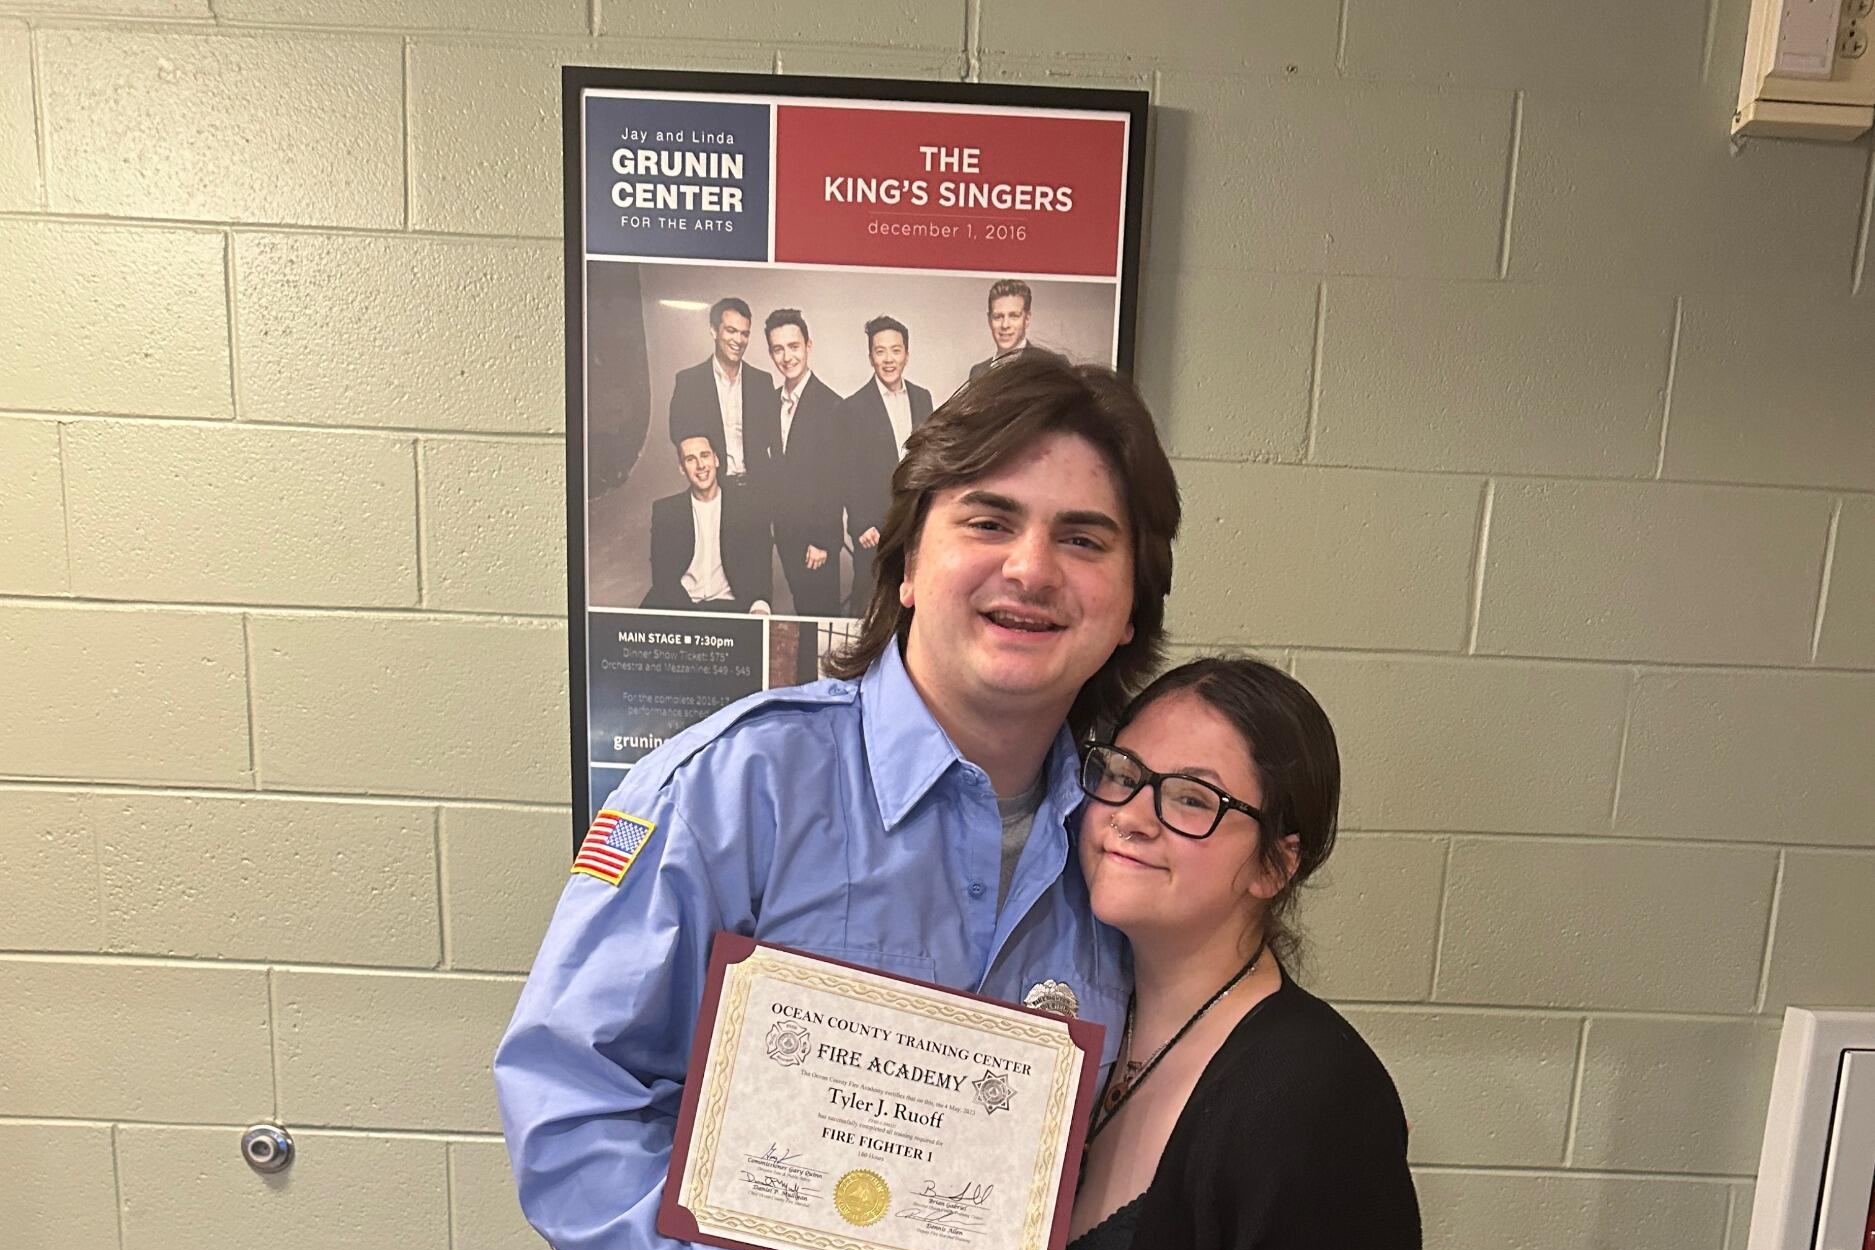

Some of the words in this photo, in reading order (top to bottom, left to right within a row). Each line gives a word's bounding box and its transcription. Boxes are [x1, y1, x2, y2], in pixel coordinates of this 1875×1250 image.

[621, 128, 647, 143] Jay
[656, 130, 684, 142] and
[692, 131, 734, 145] Linda
[612, 148, 744, 179] GRUNIN
[919, 146, 980, 174] THE
[611, 181, 743, 213] CENTER
[825, 176, 929, 206] KING'S
[938, 181, 1073, 212] SINGERS
[621, 216, 651, 228] FOR
[658, 217, 687, 230] THE
[694, 219, 733, 232] ARTS
[868, 220, 959, 238] december
[966, 224, 977, 240] 1,
[986, 224, 1027, 241] 2016
[618, 631, 646, 643] MAIN
[648, 633, 682, 645] STAGE
[694, 635, 734, 649] 7:30pm
[623, 648, 651, 658] Dinner
[653, 649, 678, 660] Show
[601, 660, 643, 671] Orchestra
[645, 662, 662, 672] and
[622, 692, 638, 701] For
[639, 692, 652, 703] the
[654, 694, 696, 706] complete
[627, 704, 682, 717] performance
[771, 1003, 824, 1024] OCEAN
[828, 1016, 892, 1041] COUNTY
[896, 1033, 969, 1060] TRAINING
[973, 1052, 1032, 1076] CENTER
[817, 1043, 862, 1068] FIRE
[867, 1056, 968, 1092] ACADEMY
[828, 1087, 874, 1112] Tyler
[874, 1098, 888, 1118] J.
[893, 1102, 945, 1129] Ruoff
[822, 1127, 856, 1145] FIRE
[859, 1136, 923, 1160] FIGHTER
[788, 1167, 804, 1176] Gary
